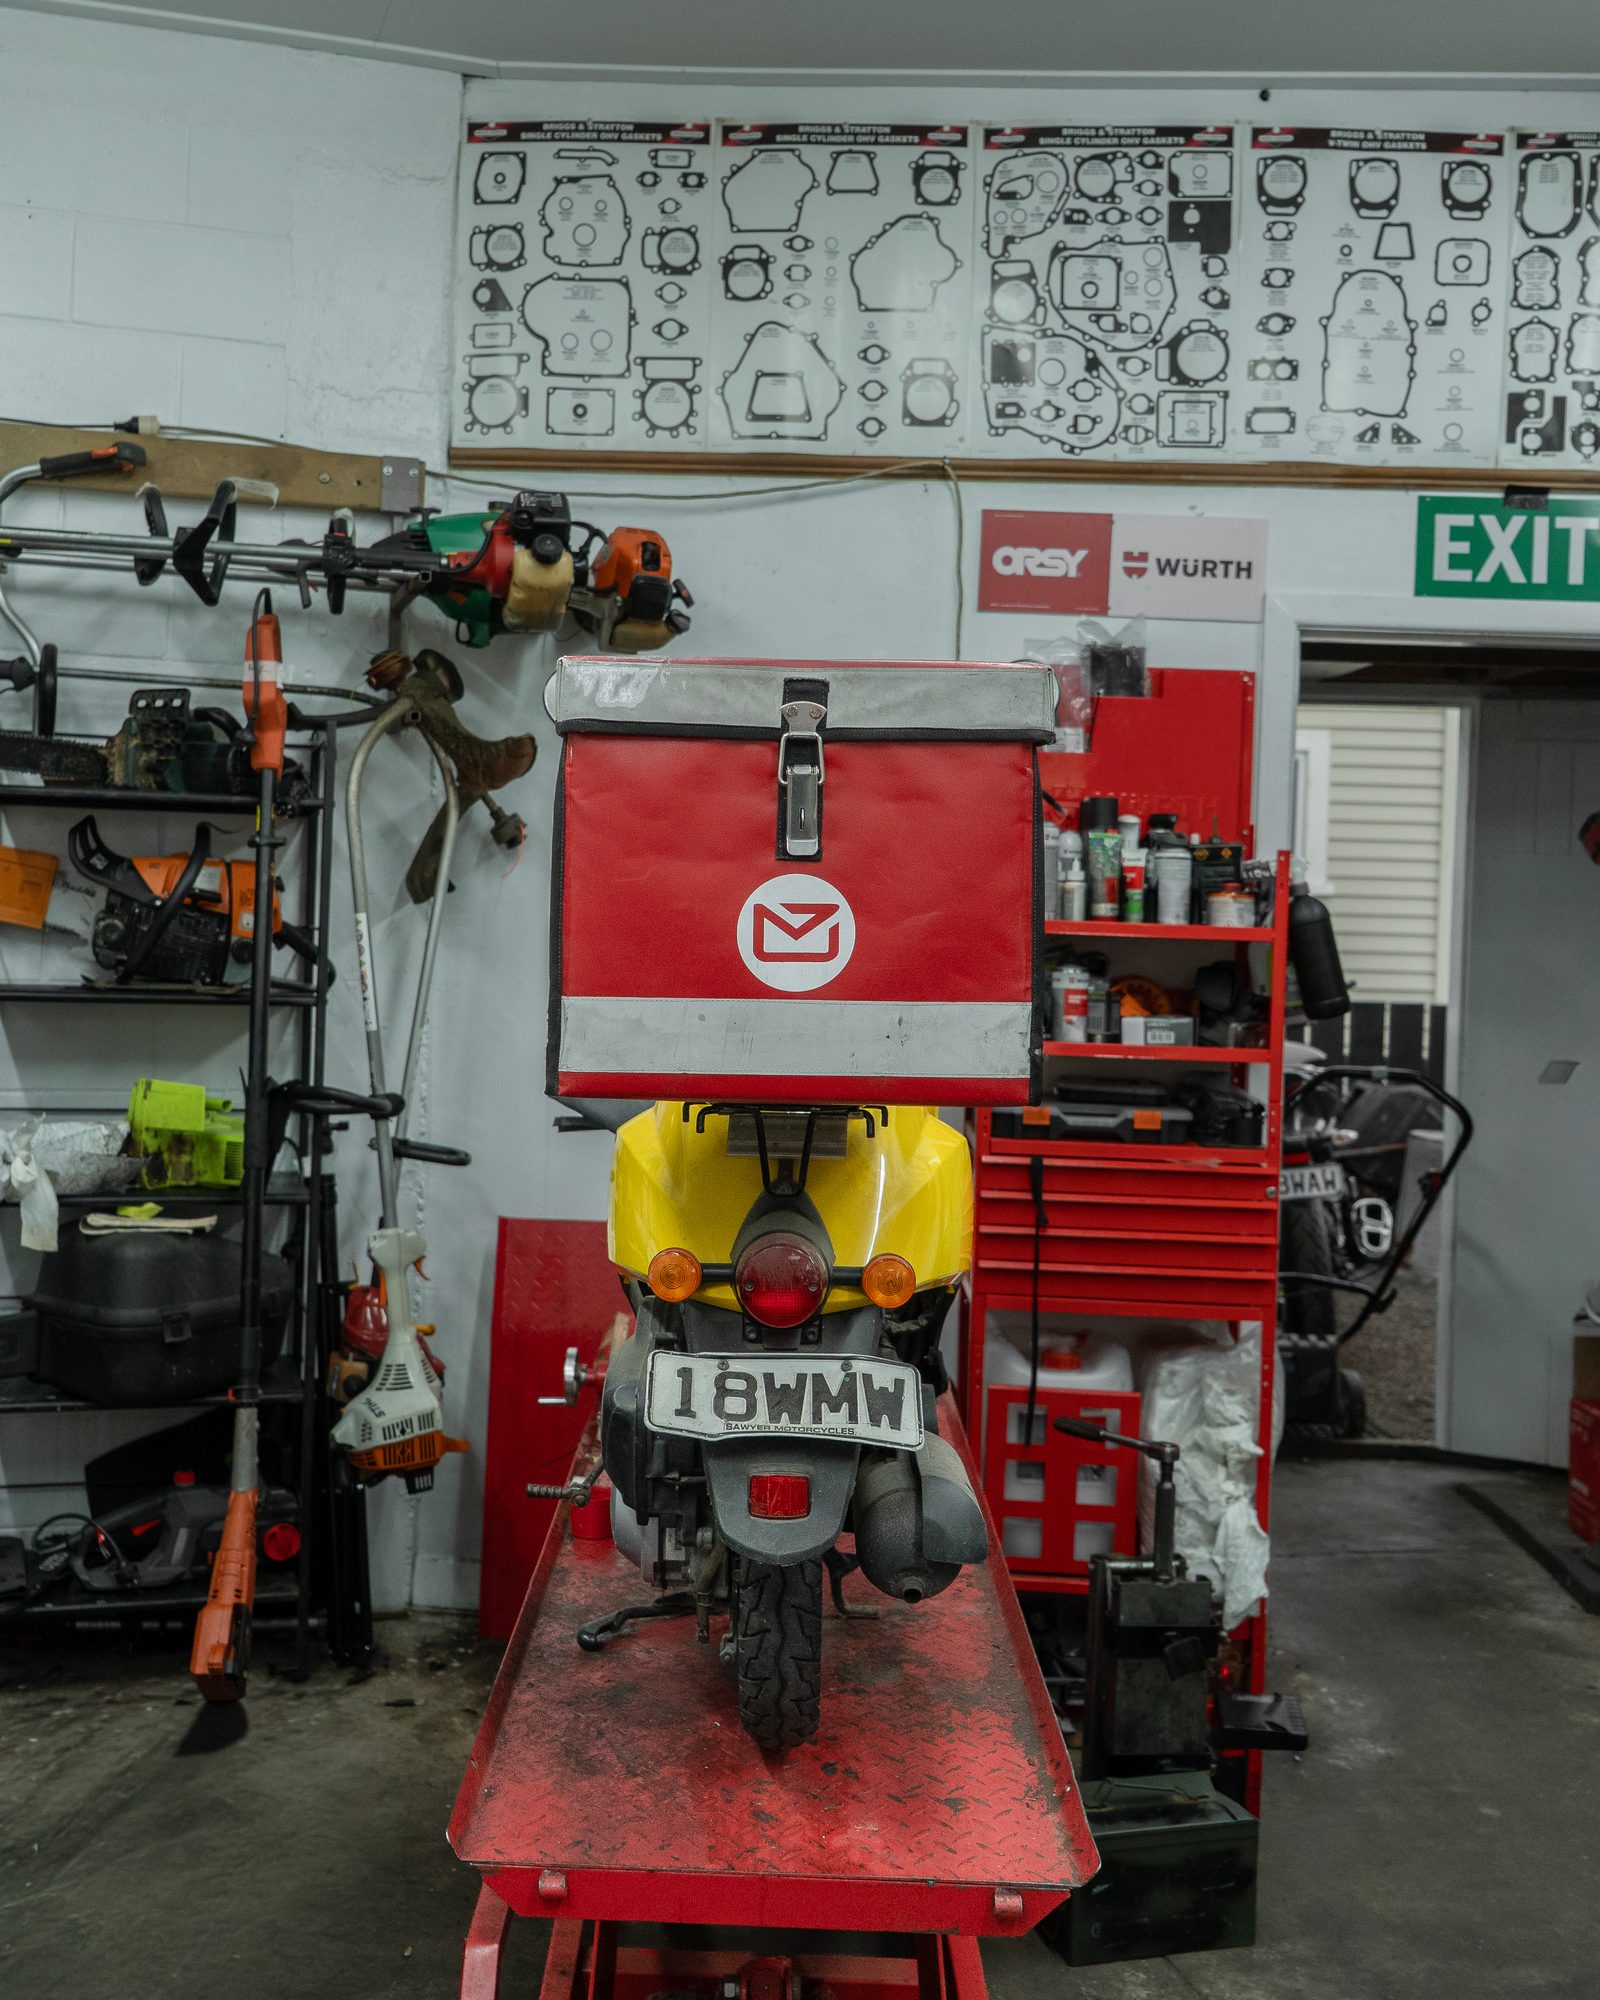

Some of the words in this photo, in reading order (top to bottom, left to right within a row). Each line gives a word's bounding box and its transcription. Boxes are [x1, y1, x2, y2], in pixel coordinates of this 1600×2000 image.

[1156, 558, 1253, 580] WÜRTH
[1432, 513, 1600, 585] EXIT
[674, 1366, 906, 1432] 18WMW
[725, 1422, 772, 1432] SAWYER
[774, 1425, 856, 1436] MOTORCYCLES
